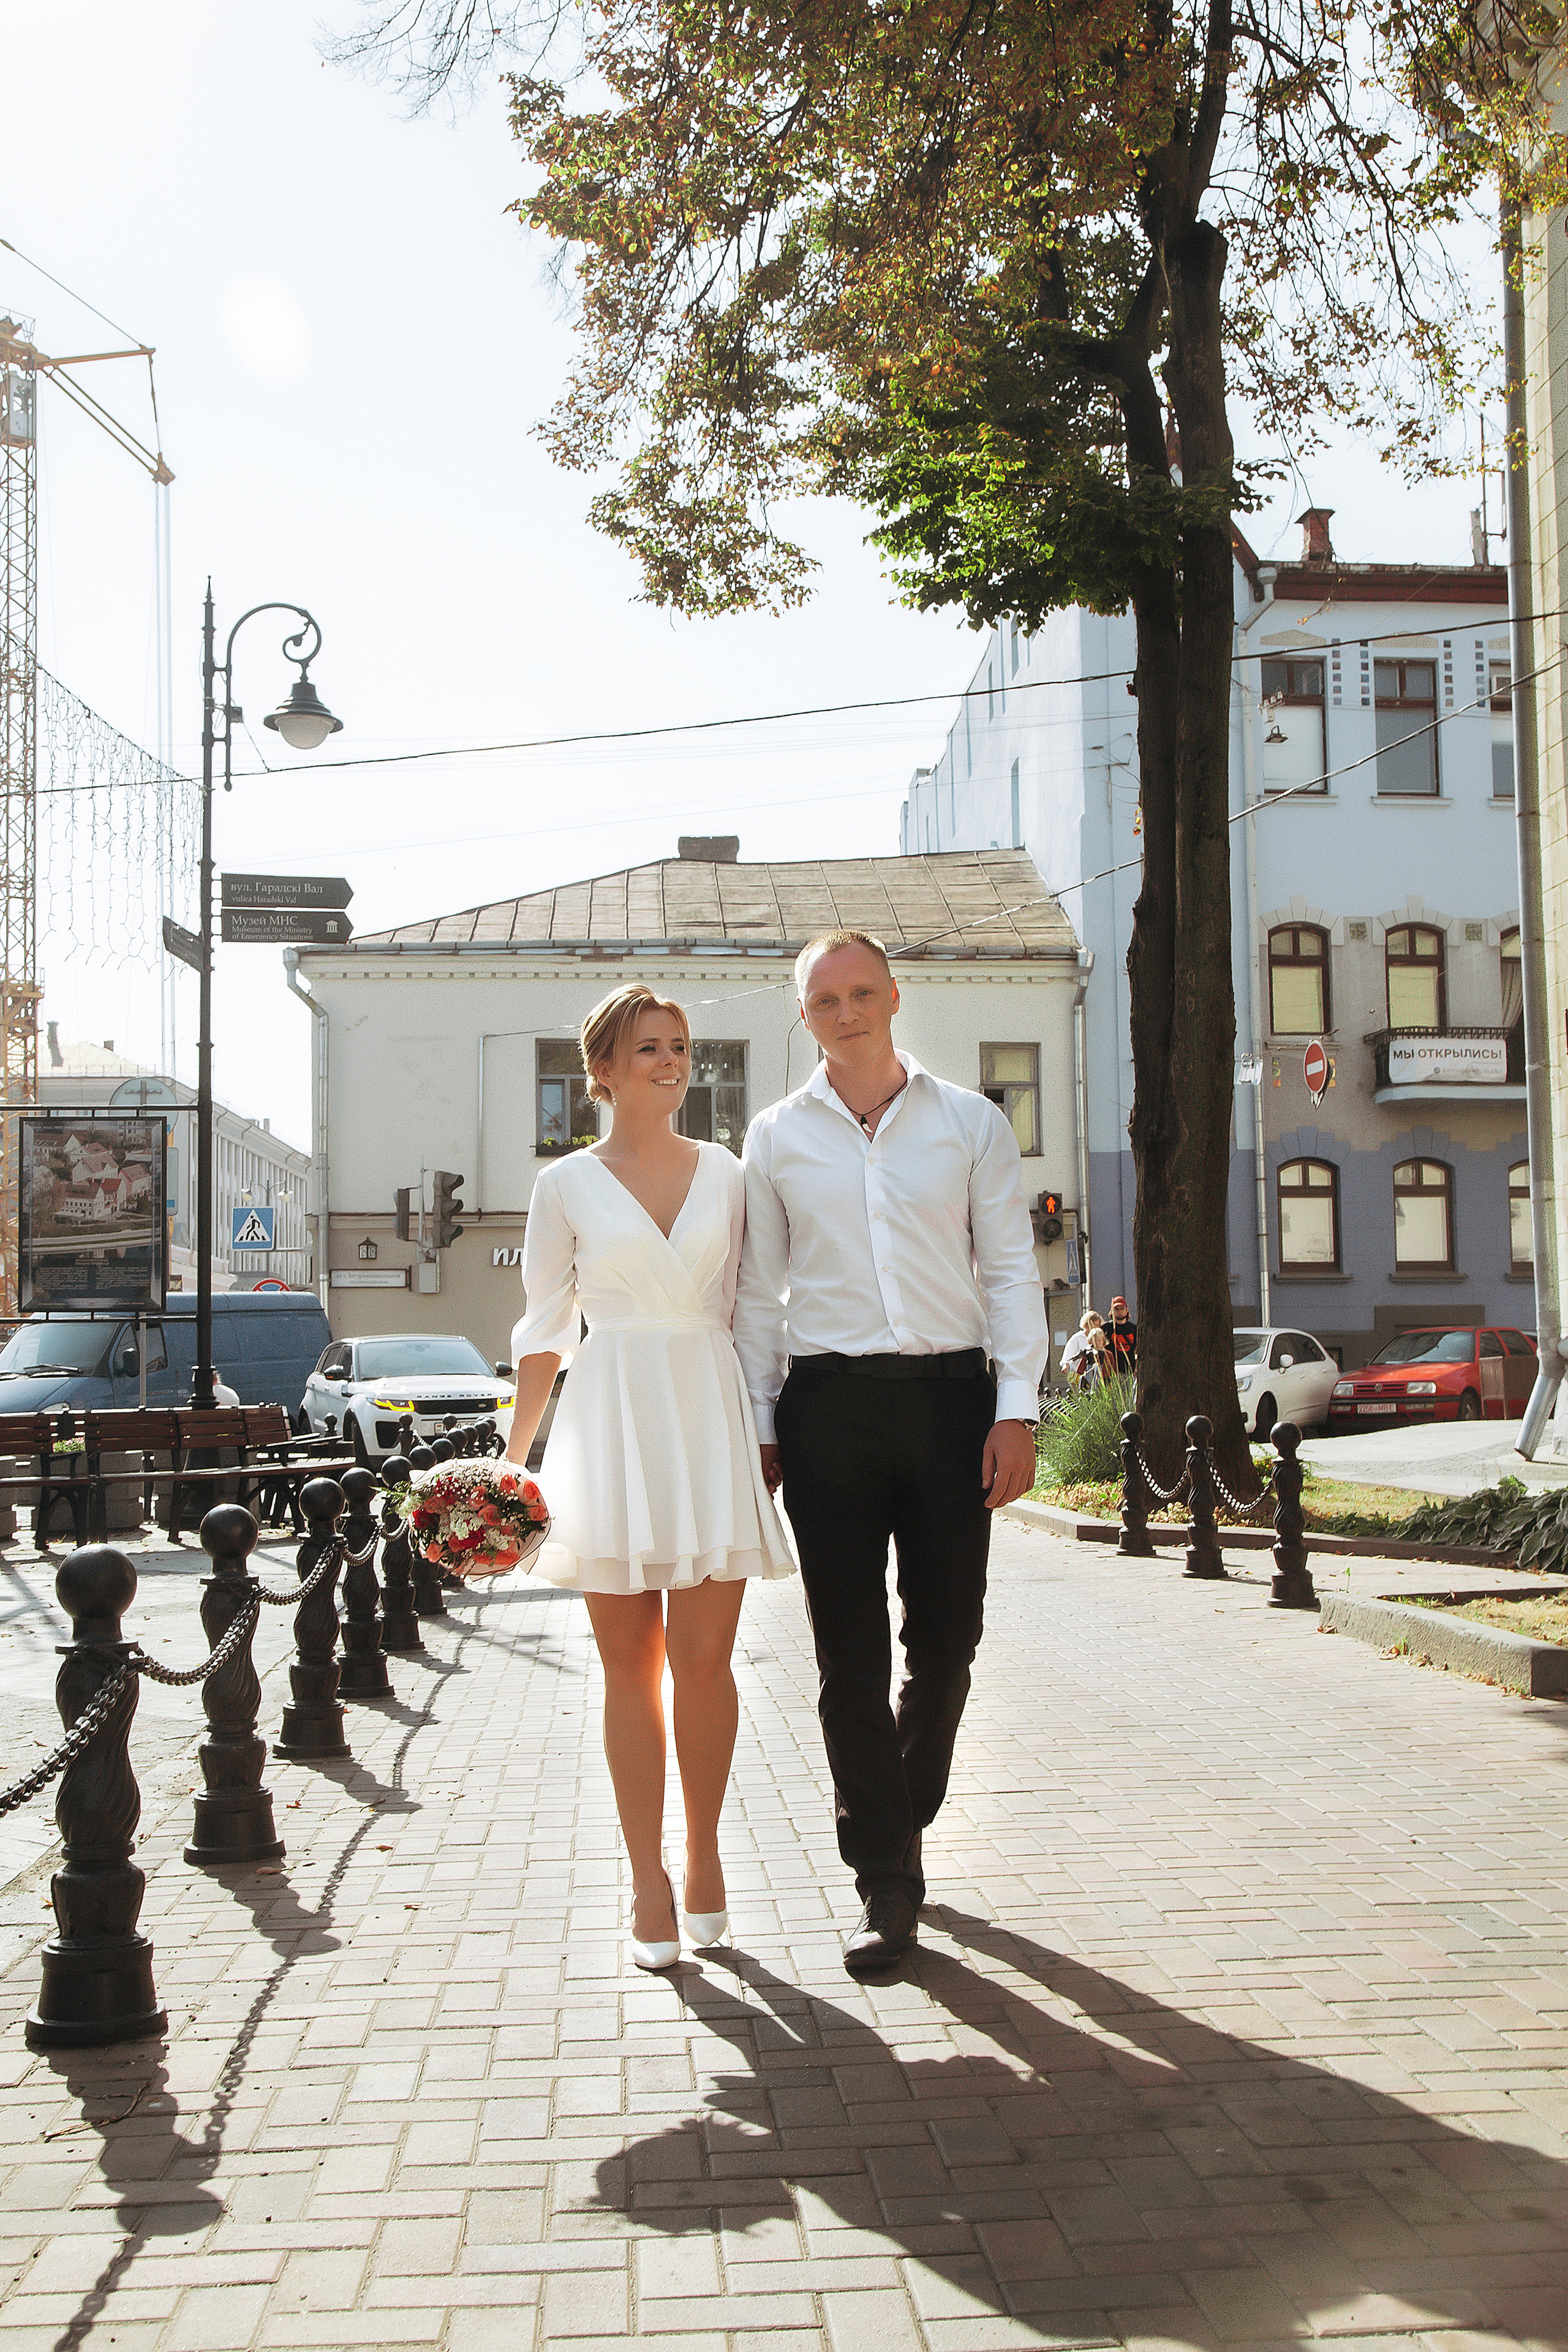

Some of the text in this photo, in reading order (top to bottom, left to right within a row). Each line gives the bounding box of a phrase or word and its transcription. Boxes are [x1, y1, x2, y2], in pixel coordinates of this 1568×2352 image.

[231, 882, 323, 895] вул. Гарадскі Вал
[232, 915, 299, 927] Музей МНС
[284, 927, 313, 935] Ministry
[1393, 1049, 1414, 1060] МЫ
